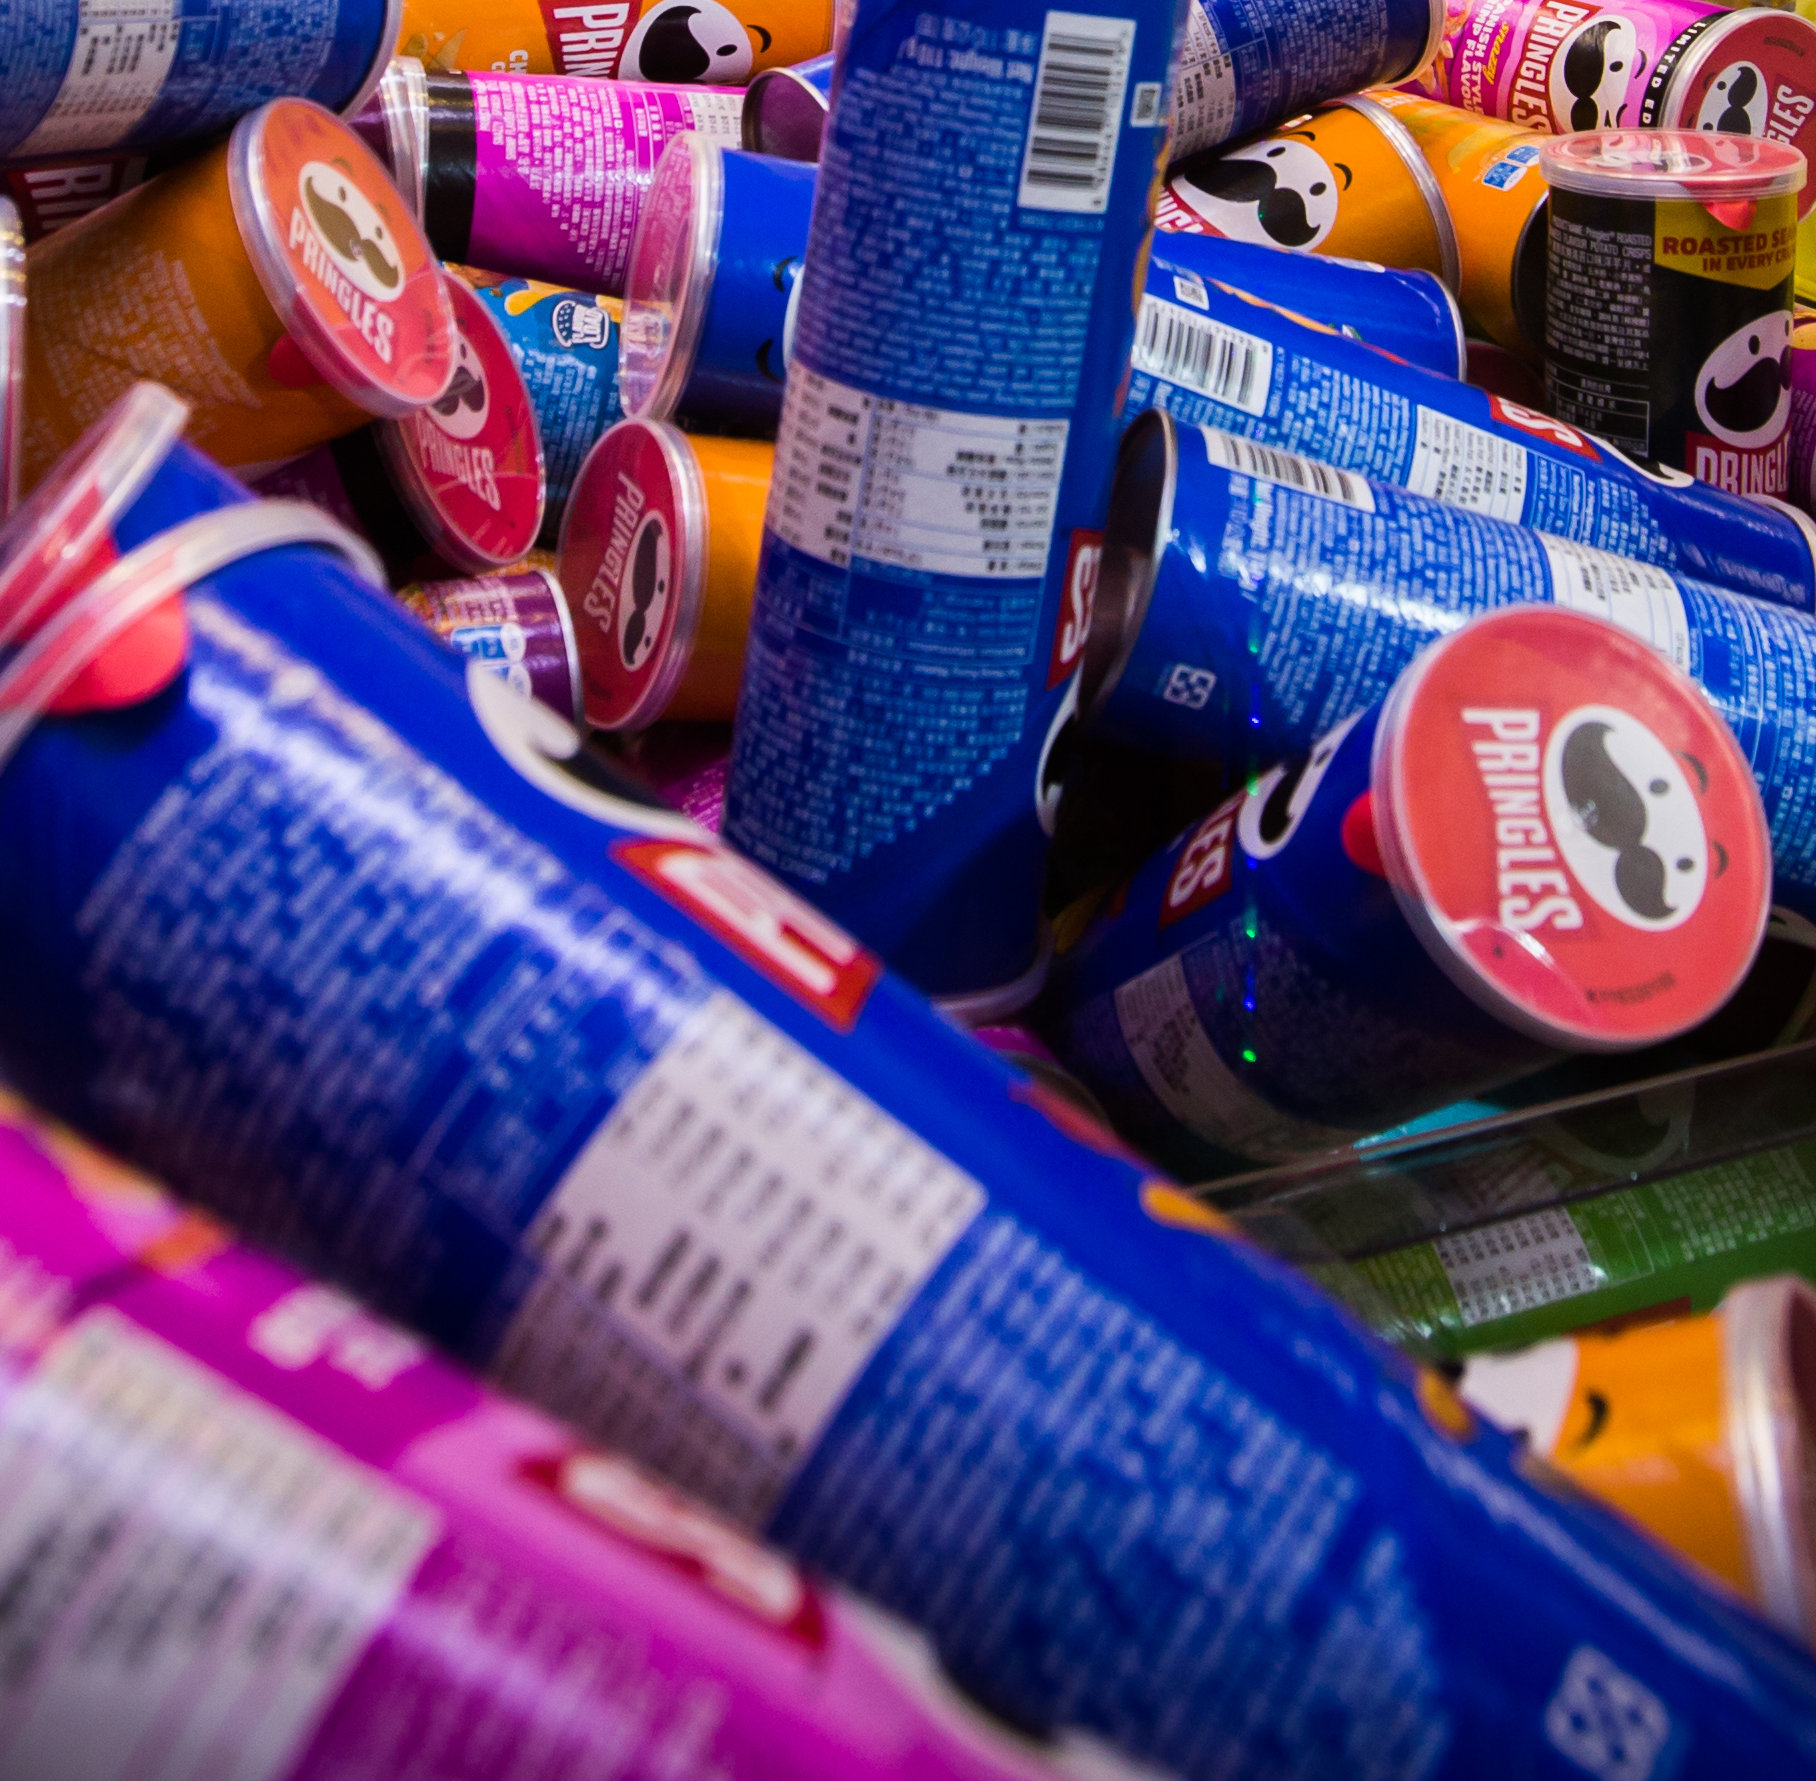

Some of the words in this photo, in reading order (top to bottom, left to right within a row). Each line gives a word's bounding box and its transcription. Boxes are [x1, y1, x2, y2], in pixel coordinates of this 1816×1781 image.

[553, 2, 630, 77] PRIN
[1462, 37, 1474, 112] FLAVOU
[1487, 20, 1509, 85] snazzy
[1511, 0, 1591, 133] PRINGLES
[1650, 21, 1707, 89] LIMITED
[1766, 83, 1816, 150] GLES
[1662, 230, 1768, 255] ROASTED
[1702, 257, 1722, 272] IN
[289, 207, 396, 366] PRINGLES
[583, 470, 646, 635] PRINGLES
[1459, 706, 1585, 933] PRINGLES
